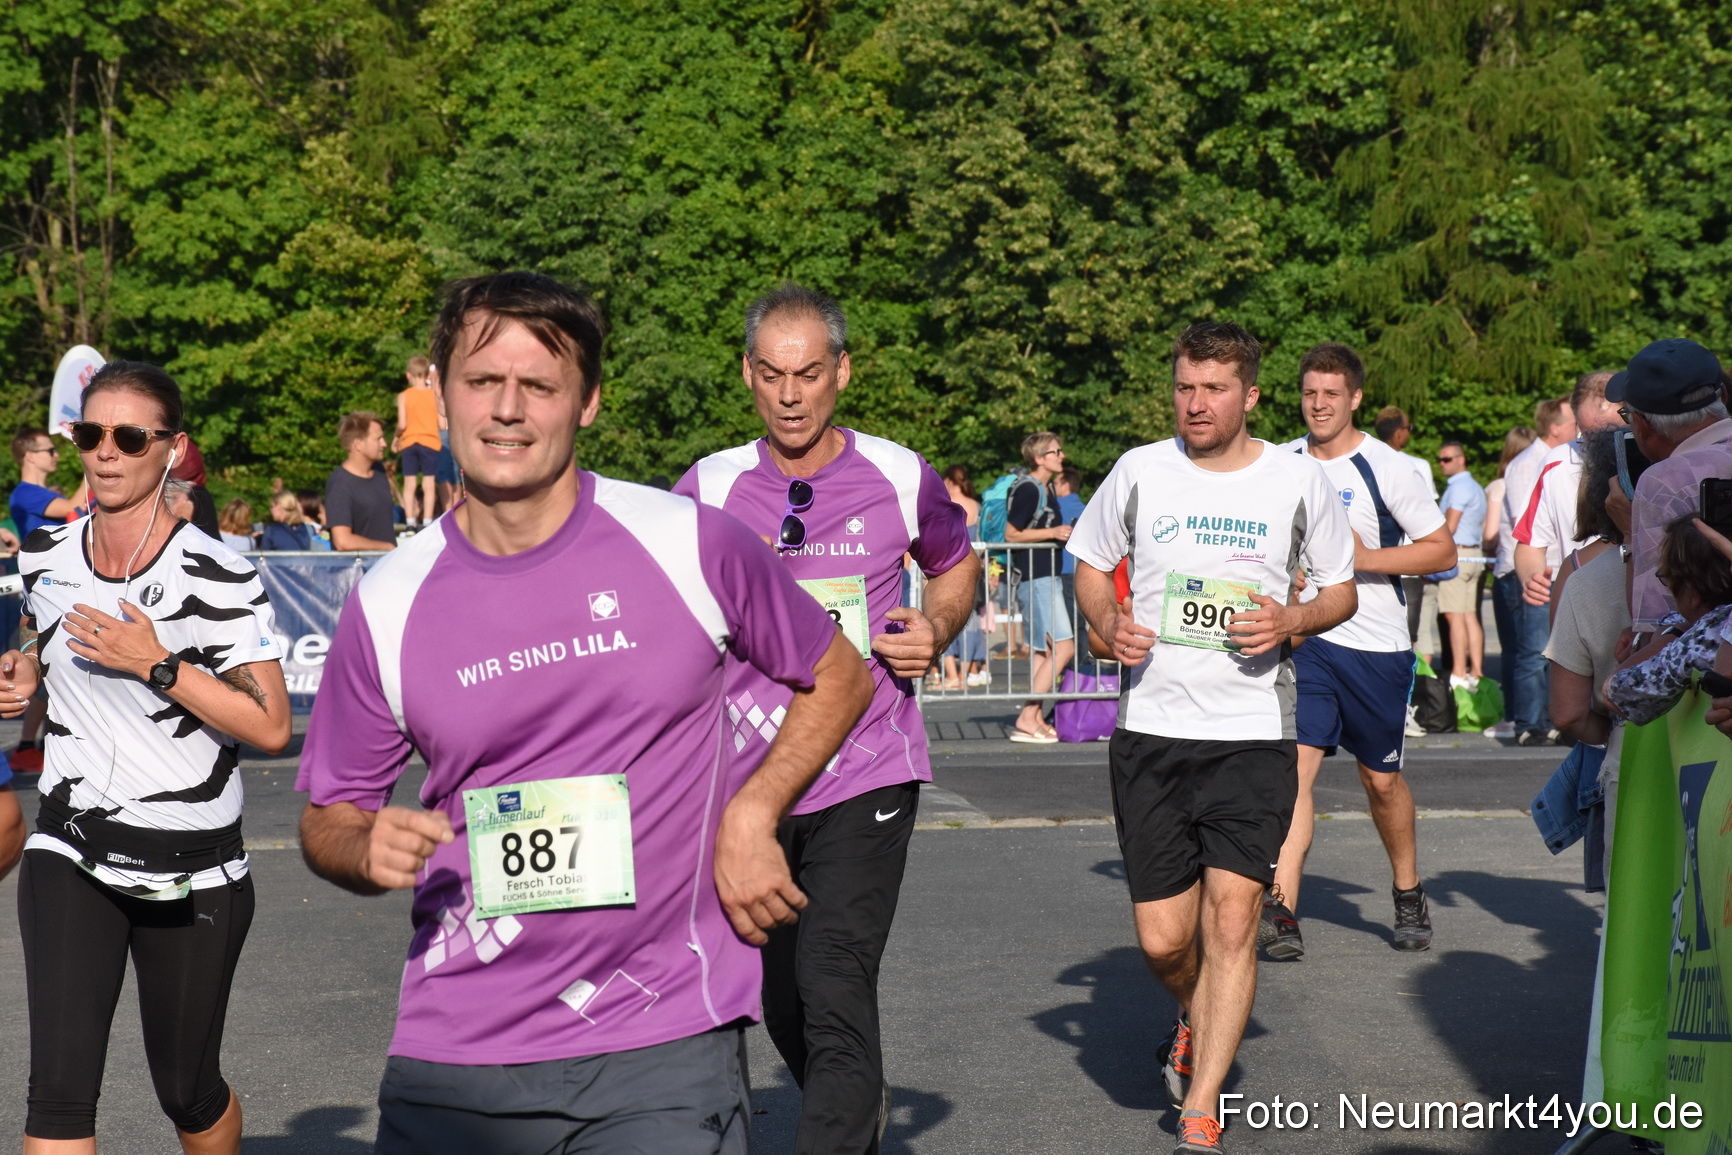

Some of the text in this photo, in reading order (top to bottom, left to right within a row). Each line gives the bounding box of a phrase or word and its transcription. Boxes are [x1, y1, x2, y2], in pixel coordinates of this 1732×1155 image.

[1186, 516, 1268, 537] HAUBNER
[830, 543, 871, 556] LILA.
[1195, 533, 1256, 549] TREPPEN
[841, 599, 860, 607] 2019
[1182, 601, 1236, 630] 990
[456, 630, 637, 687] WIR SIND LILA.
[489, 805, 546, 825] firmenlauf
[107, 852, 145, 866] FlipBelt
[502, 826, 584, 877] 887
[507, 873, 586, 891] Fersch Tobia
[502, 893, 527, 903] FUCHS
[529, 891, 535, 899] &
[537, 887, 563, 897] Söhne
